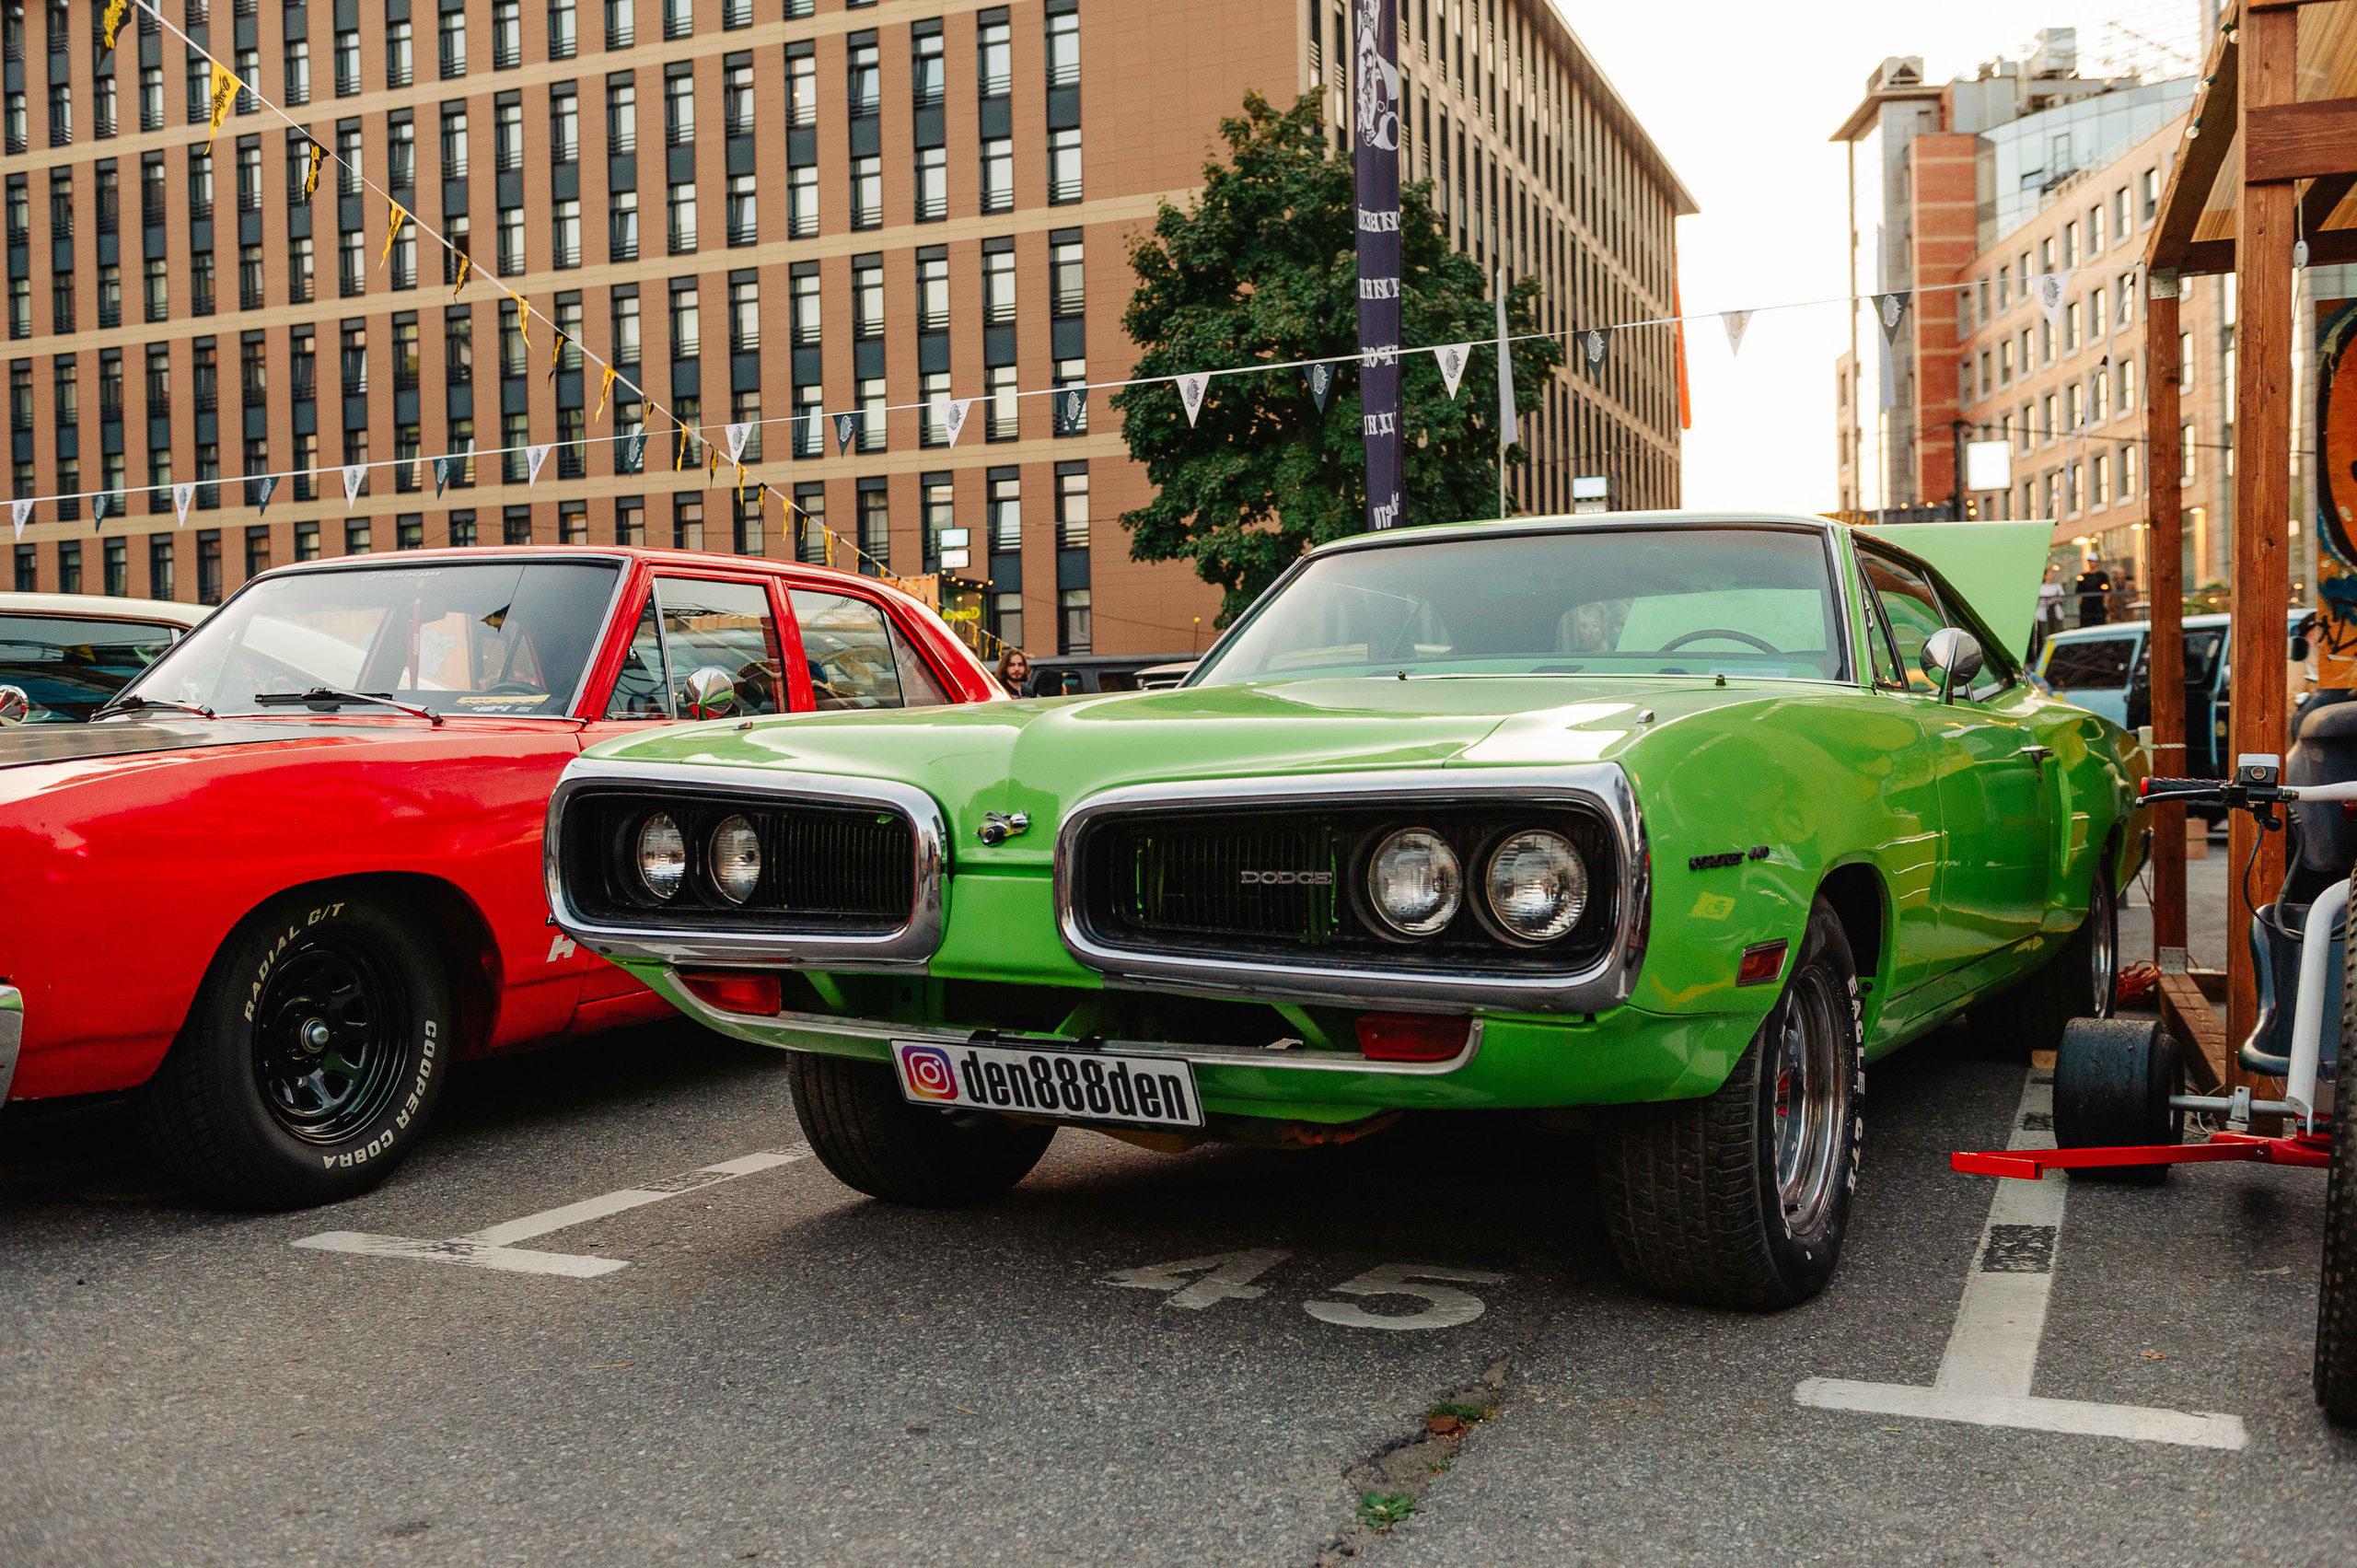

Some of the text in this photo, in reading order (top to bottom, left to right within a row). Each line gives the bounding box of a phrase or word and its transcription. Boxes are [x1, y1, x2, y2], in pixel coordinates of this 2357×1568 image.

[1240, 870, 1332, 885] DODGE
[244, 902, 345, 1023] RADIAL G/T
[322, 1019, 437, 1170] COOPER COBRA
[959, 1050, 1190, 1121] den888den
[1846, 973, 1865, 1097] EAGLE
